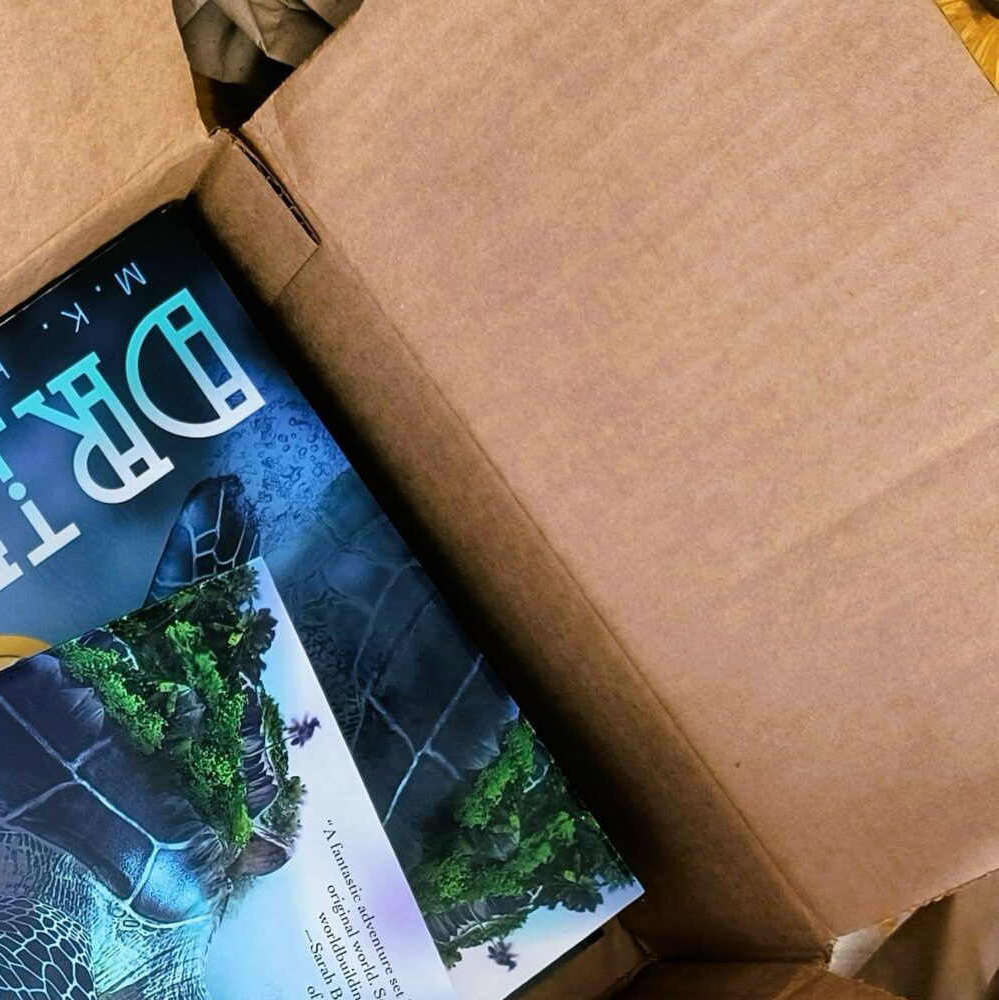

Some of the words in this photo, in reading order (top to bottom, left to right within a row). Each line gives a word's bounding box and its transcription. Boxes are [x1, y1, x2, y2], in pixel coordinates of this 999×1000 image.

[327, 885, 360, 938] original
[353, 940, 379, 986] world.
[330, 842, 362, 903] fantastic
[357, 905, 393, 975] adventure
[390, 977, 404, 998] set
[307, 985, 324, 1000] of
